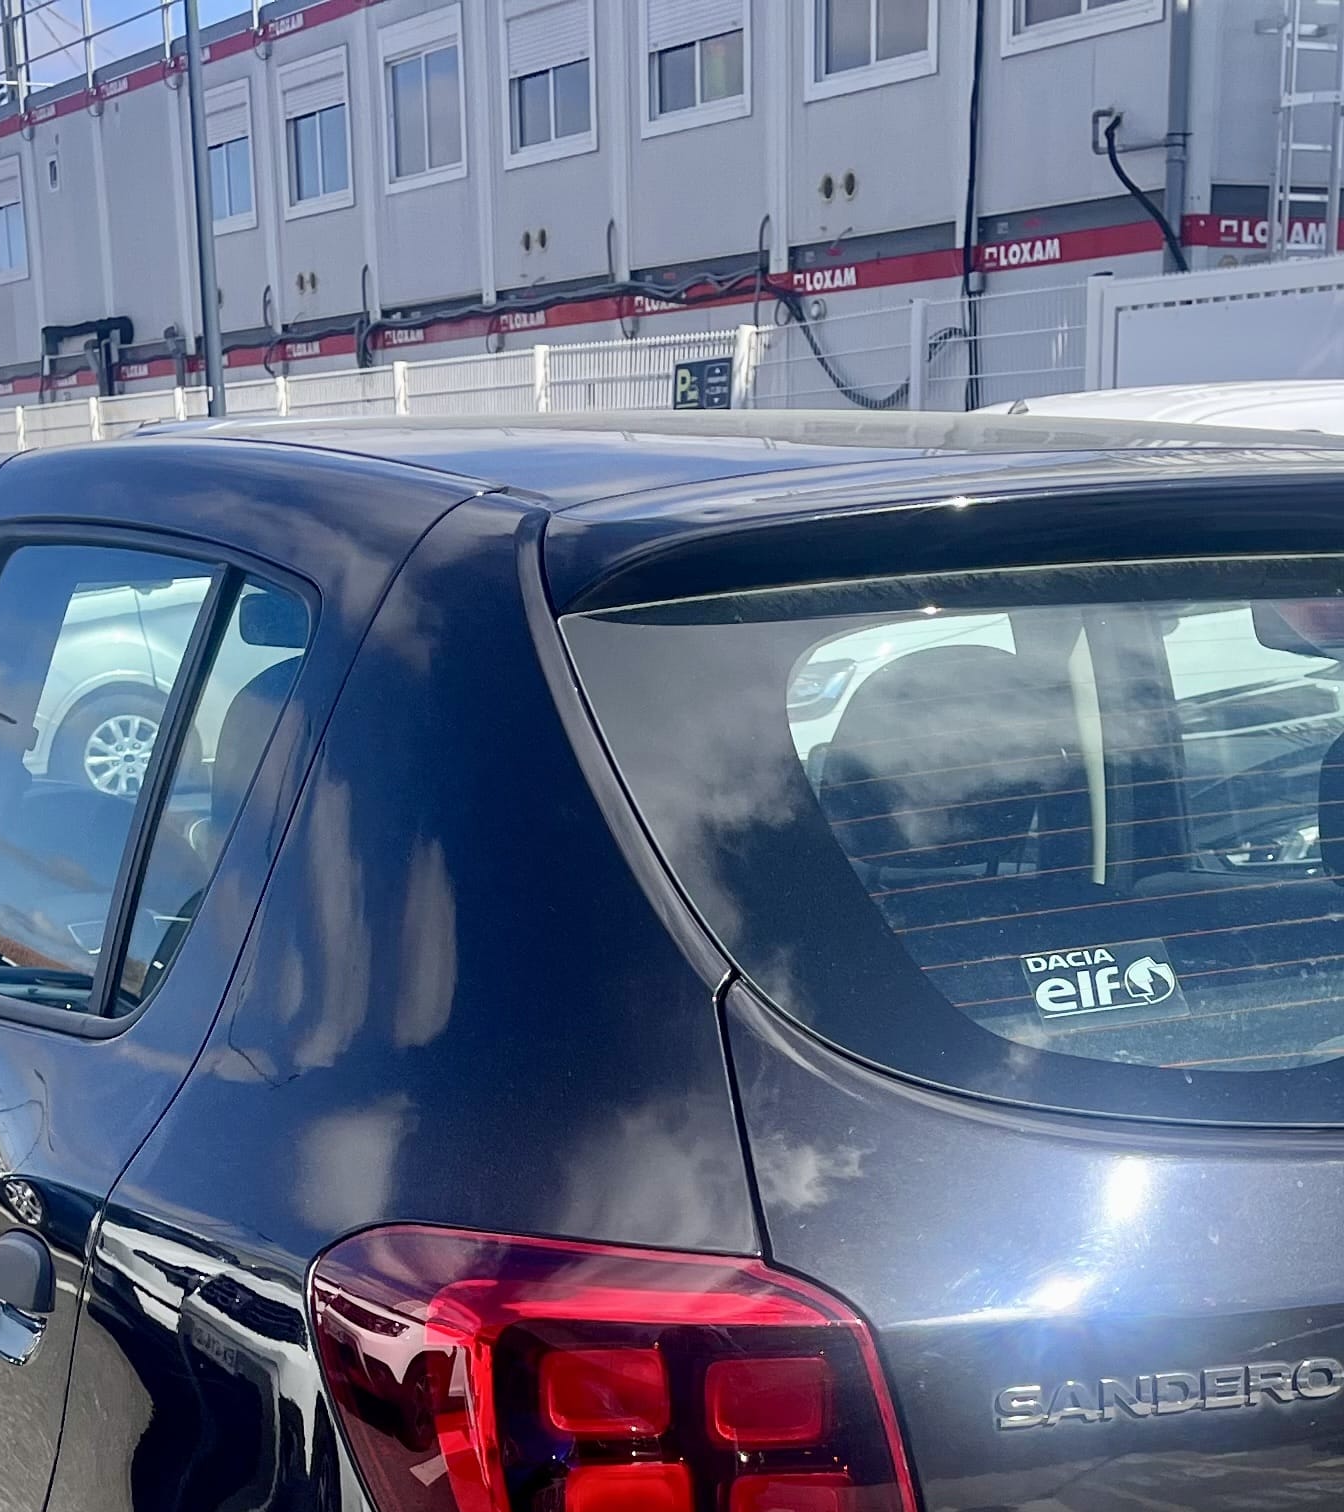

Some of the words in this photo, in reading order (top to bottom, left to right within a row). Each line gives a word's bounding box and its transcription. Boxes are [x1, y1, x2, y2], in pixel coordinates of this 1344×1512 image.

[1242, 220, 1326, 245] LOAM
[998, 238, 1061, 266] LOXAM
[806, 266, 857, 291] LOXAM
[509, 309, 546, 331] LOXAM
[1025, 948, 1116, 973] DACIA
[1035, 966, 1121, 1013] elf
